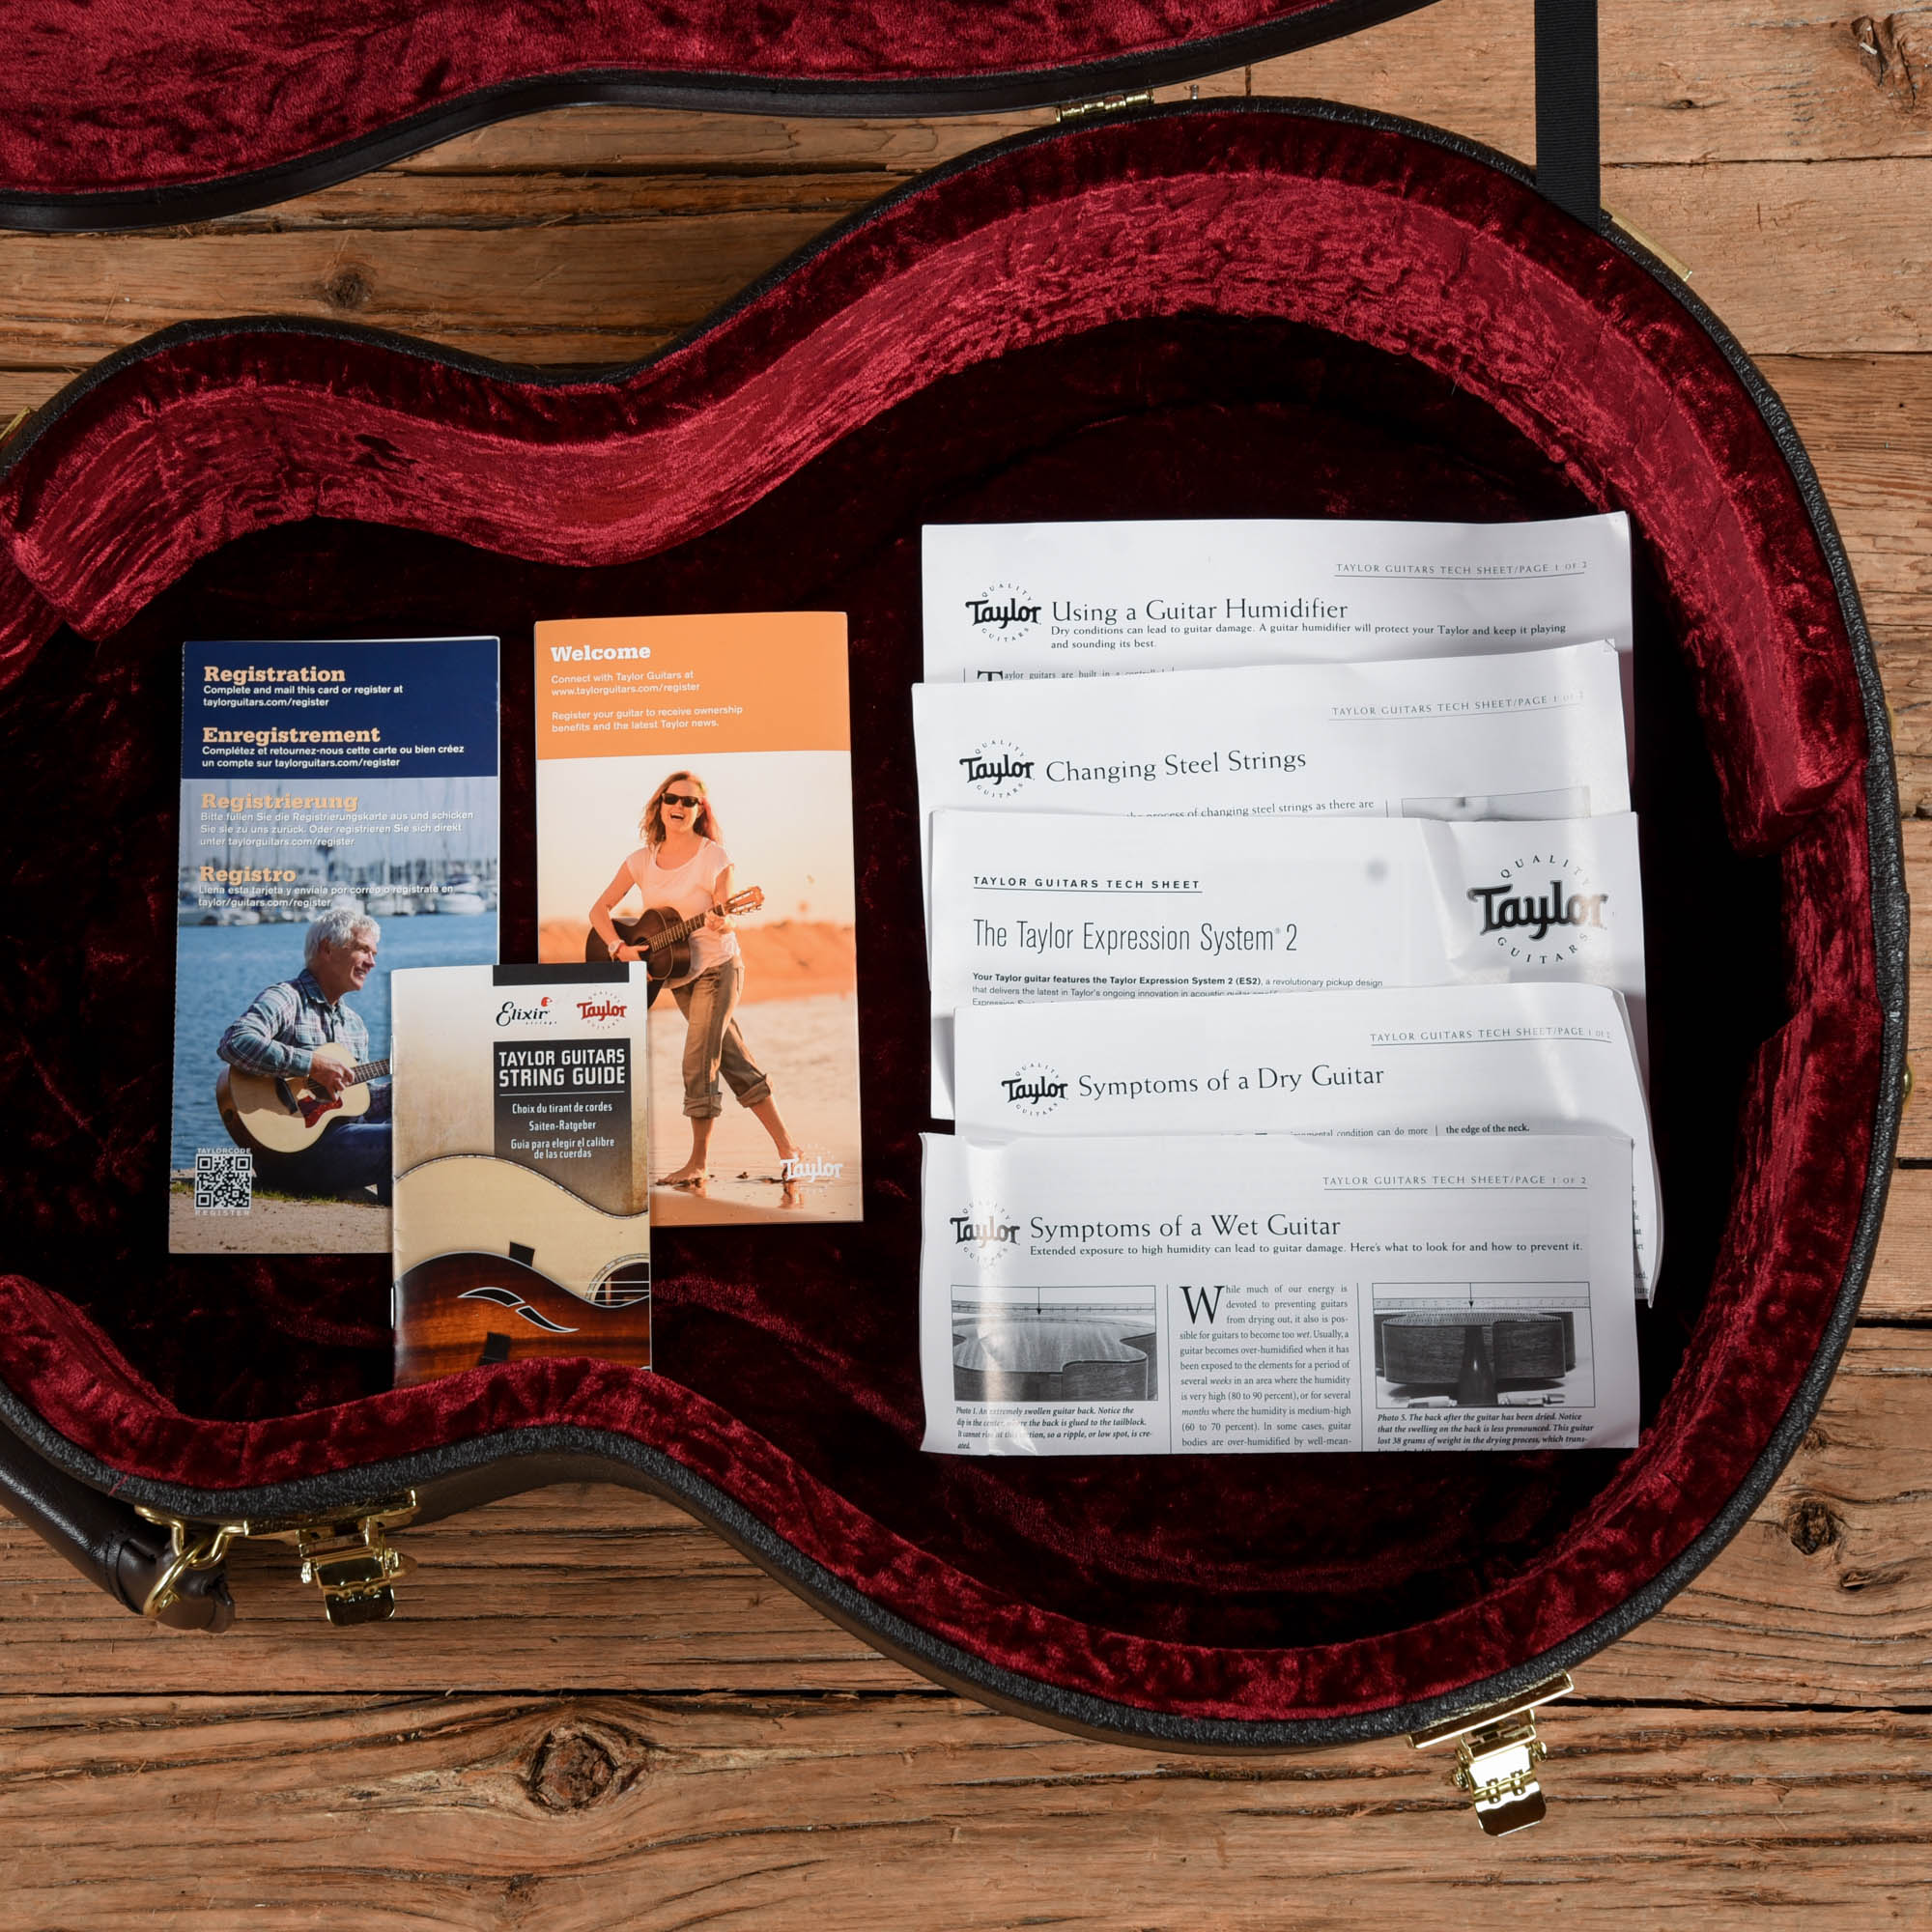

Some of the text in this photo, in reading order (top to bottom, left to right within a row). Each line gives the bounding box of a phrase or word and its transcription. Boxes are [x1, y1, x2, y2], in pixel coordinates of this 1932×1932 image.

[1336, 563, 1548, 575] TAYLOR GUITARS TECH SHEET/PAGE
[965, 597, 1042, 629] Taylor
[1053, 598, 1348, 624] Using a Guitar Humidifier
[1051, 639, 1068, 648] and
[1072, 639, 1115, 649] sounding
[551, 645, 650, 662] Welcome
[204, 667, 345, 686] Registration
[552, 674, 590, 683] Connect
[616, 672, 643, 682] Taylor
[684, 670, 693, 679] at
[204, 685, 250, 696] Complete
[355, 685, 391, 694] register
[552, 683, 699, 696] www.taylorguitars.com/register
[204, 697, 328, 707] taylorguitars.com/register
[553, 711, 590, 721] Register
[594, 712, 615, 722] your
[616, 709, 643, 723] guitar
[659, 707, 692, 717] receive
[694, 705, 743, 715] ownership
[553, 724, 590, 732] benefits
[661, 720, 689, 729] Taylor
[203, 727, 381, 746] Enregistrement
[203, 746, 255, 756] Complétez
[415, 745, 436, 753] bien
[217, 759, 253, 768] compte
[275, 758, 400, 768] taylorguitars.com/register
[959, 753, 1036, 785] Taylor
[1046, 750, 1305, 783] Changing Steel Strings
[201, 793, 358, 812] Registrierung
[199, 867, 297, 886] Registro
[974, 876, 1198, 890] TAYLOR GUITARS TECH SHEET
[198, 896, 331, 909] taylor/guitars.com/register
[1466, 879, 1608, 942] Taylor
[974, 920, 1007, 947] The
[1016, 921, 1073, 953] Taylor
[1084, 923, 1189, 955] Expression
[1287, 923, 1296, 951] 2
[996, 974, 1021, 982] Taylor
[1110, 977, 1136, 985] Taylor
[1140, 977, 1188, 985] Expression
[1273, 978, 1323, 988] revolutionary
[1326, 978, 1352, 987] pickup
[1355, 980, 1382, 988] design
[496, 1001, 550, 1027] Elixir
[577, 1000, 627, 1021] Taylor
[499, 1049, 624, 1066] TAYLOR GUITARS
[499, 1066, 625, 1087] STRING GUIDE
[1079, 1065, 1383, 1100] Symptoms of a Dry Guitar
[1001, 1075, 1068, 1104] Taylor
[513, 1101, 612, 1114] Choix du tirant de cordes
[529, 1120, 596, 1132] Saiten-Ratgeber
[531, 1141, 550, 1151] para
[553, 1138, 575, 1150] elegir
[578, 1137, 584, 1147] el
[586, 1137, 614, 1147] calibre
[533, 1148, 591, 1158] de las cuerdas
[781, 1155, 842, 1182] Taylor
[1322, 1176, 1545, 1186] TAYLOR GUITARS TECH SHEET/PAGE
[950, 1214, 1020, 1248] Taylor
[1031, 1214, 1341, 1242] Symptoms of a Wet Guitar
[1180, 1347, 1203, 1357] guitar
[1206, 1346, 1238, 1354] becomes
[1241, 1345, 1303, 1353] over-humidified
[1408, 1425, 1437, 1435] swelling
[1570, 1424, 1594, 1433] guitar
[1182, 1437, 1208, 1446] bodies
[1294, 1437, 1303, 1447] by
[1308, 1436, 1351, 1445] well-mean-
